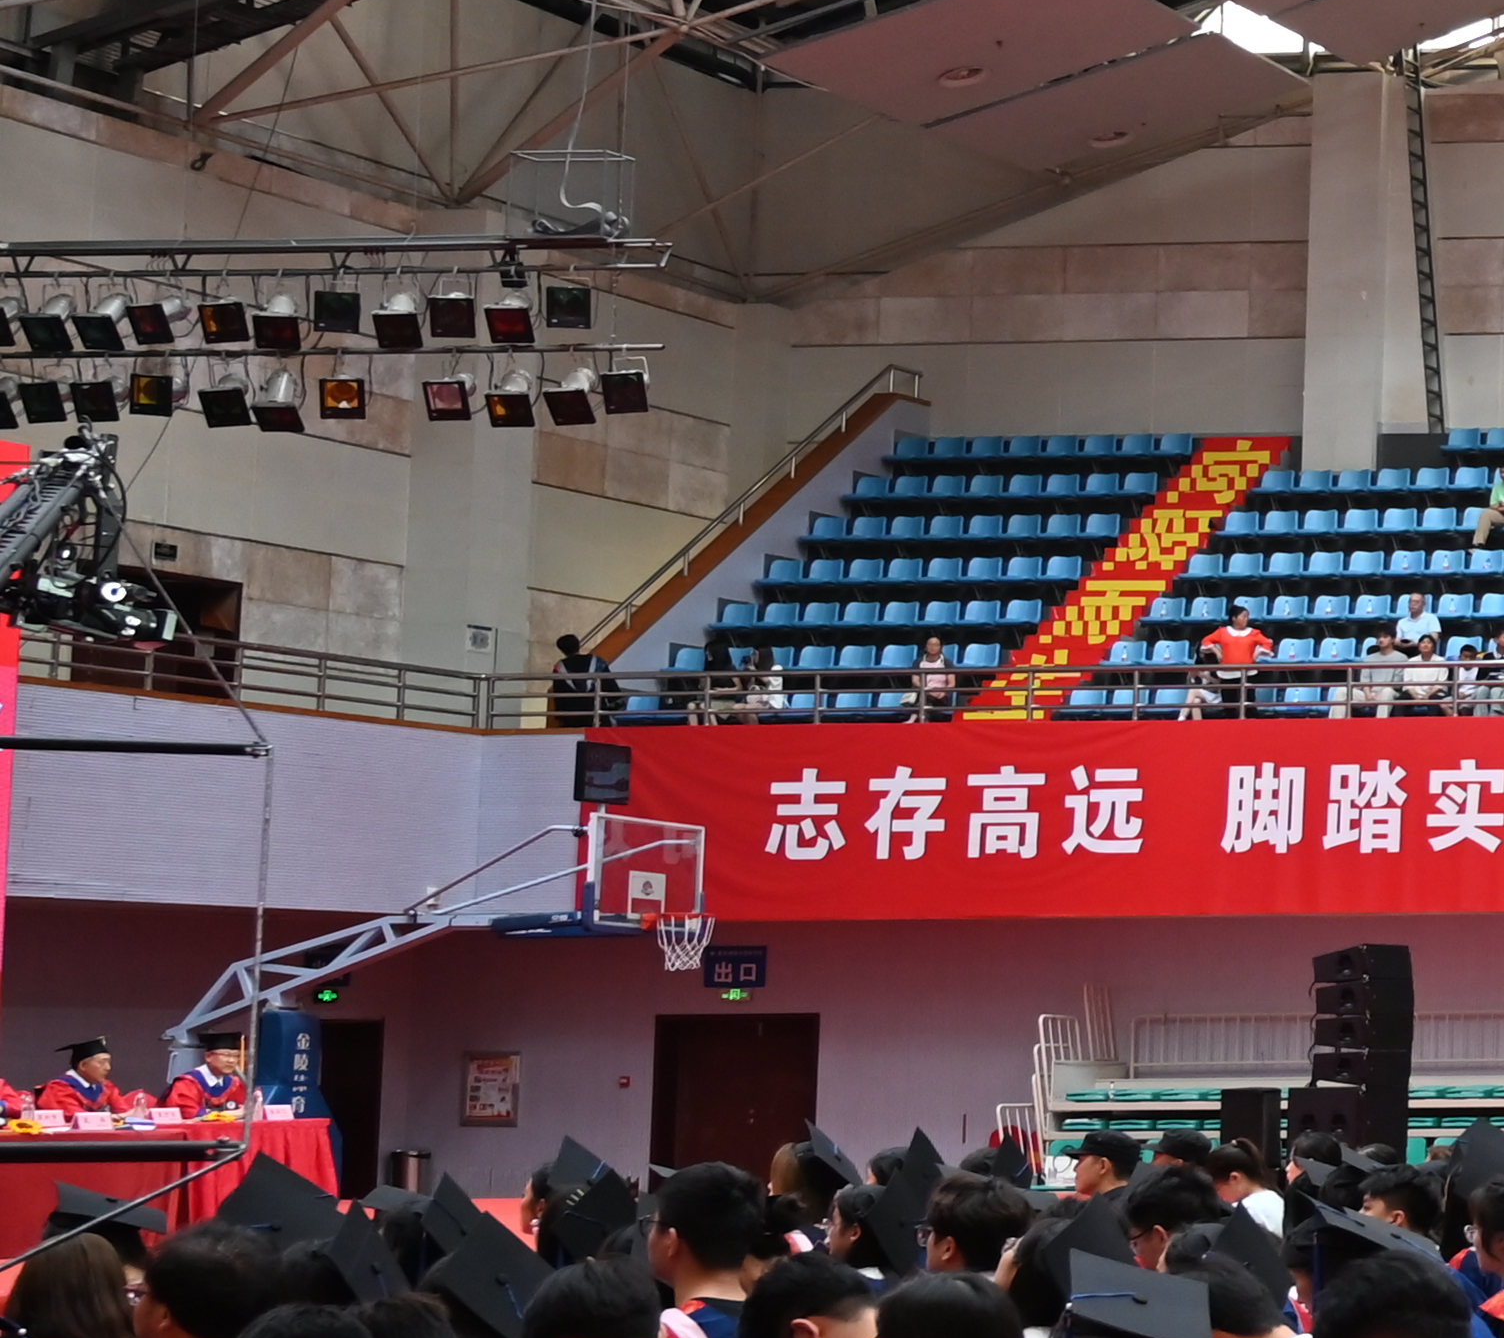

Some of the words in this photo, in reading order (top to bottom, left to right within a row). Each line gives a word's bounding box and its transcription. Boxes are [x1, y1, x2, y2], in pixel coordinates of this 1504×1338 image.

[962, 439, 1271, 720] 向阳而生
[764, 764, 1143, 860] 志存高远
[713, 961, 757, 983] 出口
